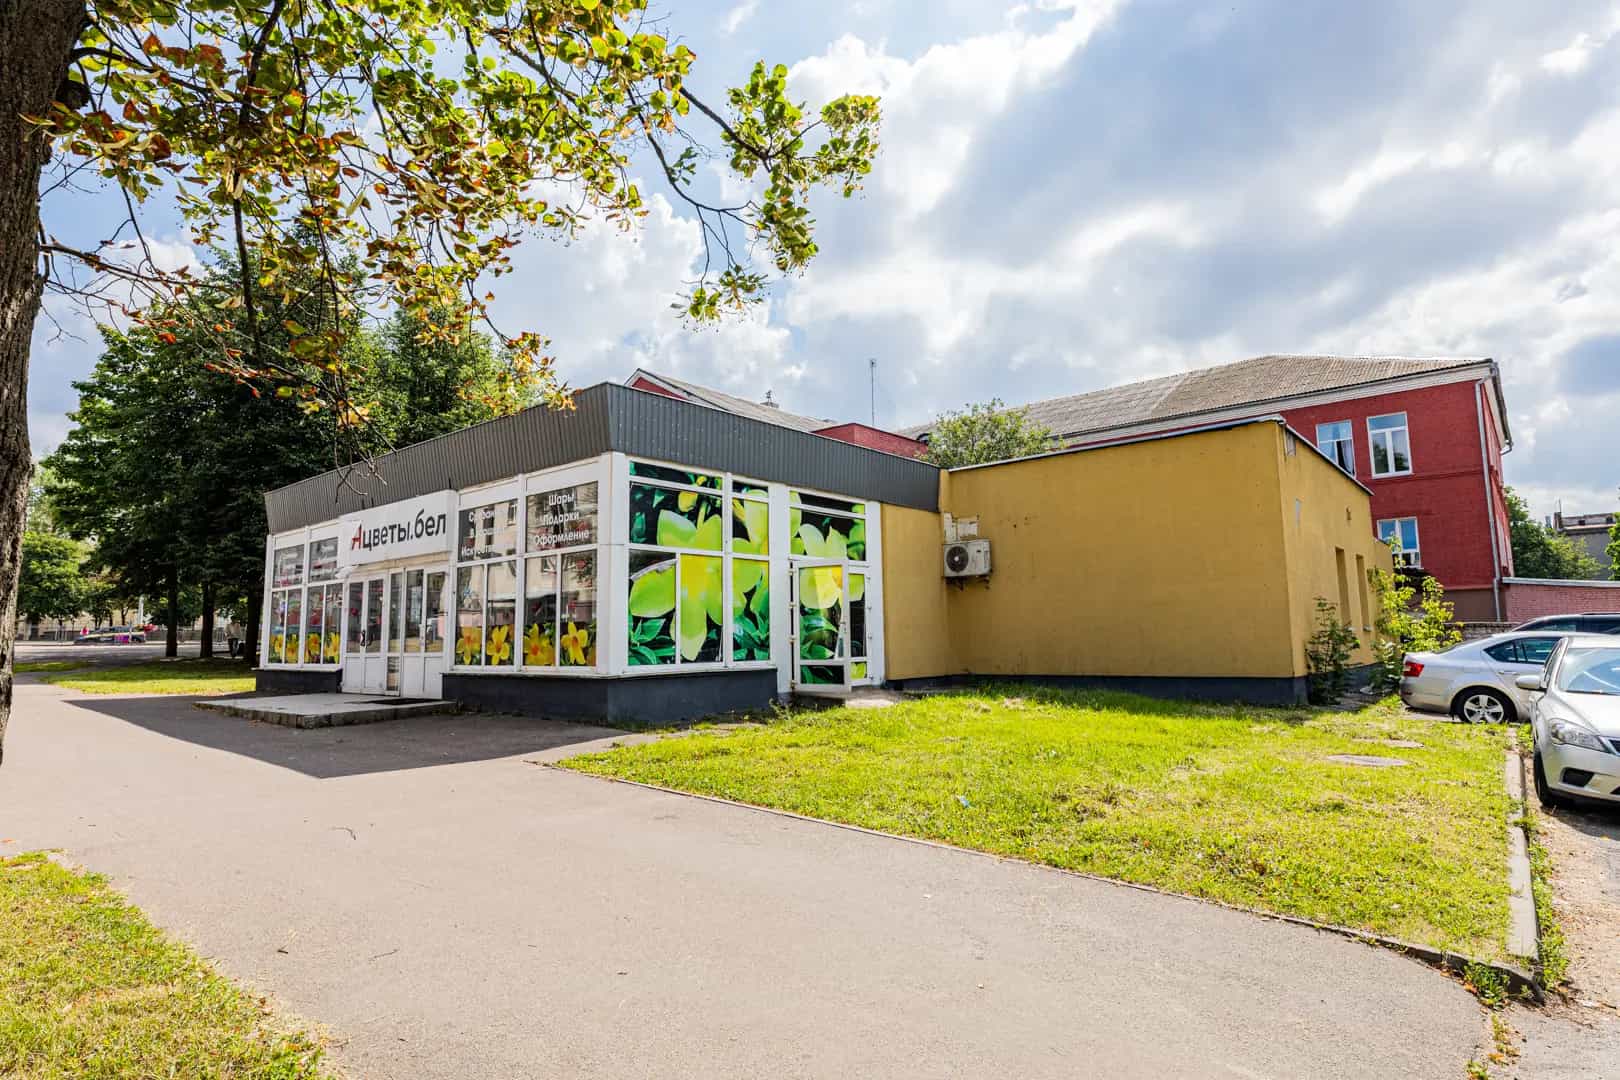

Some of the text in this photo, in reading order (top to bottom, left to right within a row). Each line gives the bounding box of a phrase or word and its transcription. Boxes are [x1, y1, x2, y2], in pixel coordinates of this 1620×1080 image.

[548, 493, 575, 508] Шары
[543, 512, 580, 527] Подарки
[351, 508, 447, 551] Ацветы.бел
[534, 529, 590, 546] Оформление
